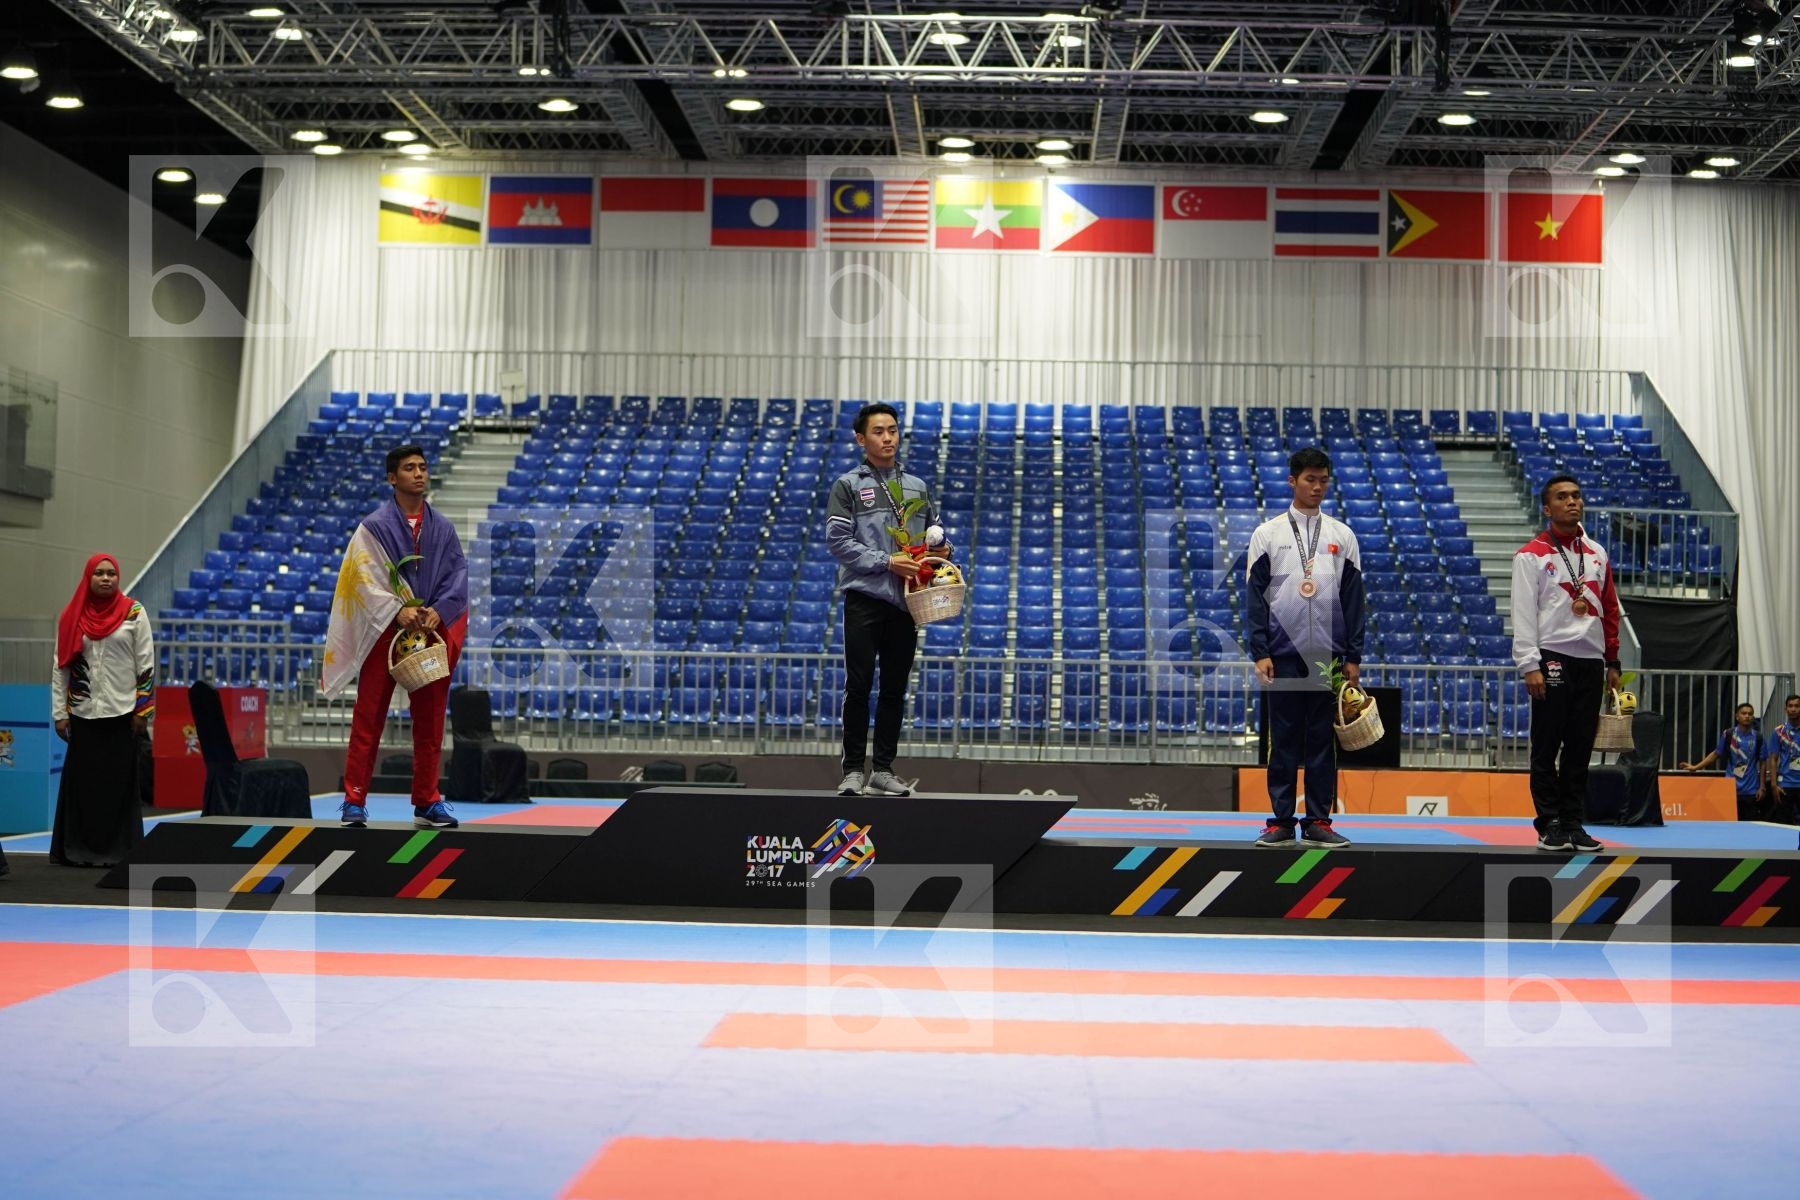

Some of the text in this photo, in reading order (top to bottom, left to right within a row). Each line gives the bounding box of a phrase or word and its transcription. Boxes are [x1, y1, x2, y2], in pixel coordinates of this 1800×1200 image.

[241, 696, 258, 712] COACH
[747, 835, 804, 849] KUALA
[746, 850, 815, 864] LUMPUR
[746, 864, 784, 878] 2017
